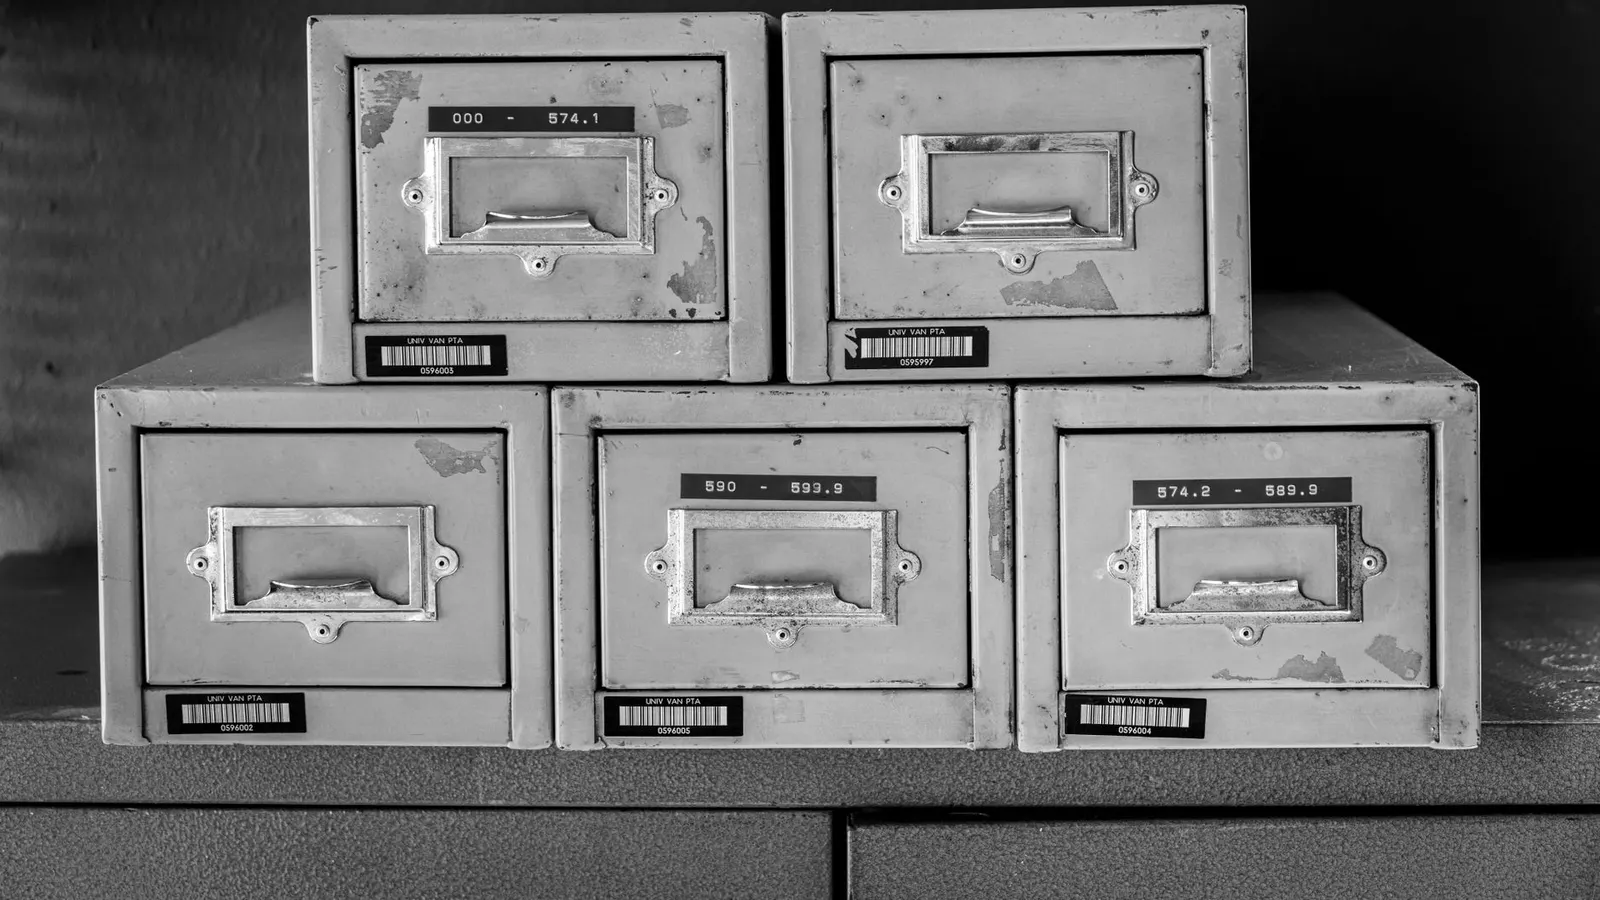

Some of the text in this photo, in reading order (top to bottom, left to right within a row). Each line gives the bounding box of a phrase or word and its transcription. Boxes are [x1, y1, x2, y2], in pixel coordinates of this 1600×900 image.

[452, 112, 483, 124] 000
[548, 112, 599, 125] 574.1
[909, 328, 927, 336] VAN
[929, 327, 946, 335] PTA
[407, 337, 425, 345] UNIV
[899, 358, 934, 366] 0595997
[420, 366, 454, 375] 0596003
[705, 480, 737, 493] 590
[790, 481, 843, 495] 599.9
[1157, 485, 1211, 499] 574.2
[1265, 483, 1318, 497] 589.9
[207, 695, 225, 703] UNIV
[685, 697, 701, 705] PTA
[1107, 696, 1164, 706] UNIV VAN PTA
[220, 724, 254, 732] 0596002
[657, 726, 691, 735] 0596005
[1118, 726, 1152, 735] 0596004
